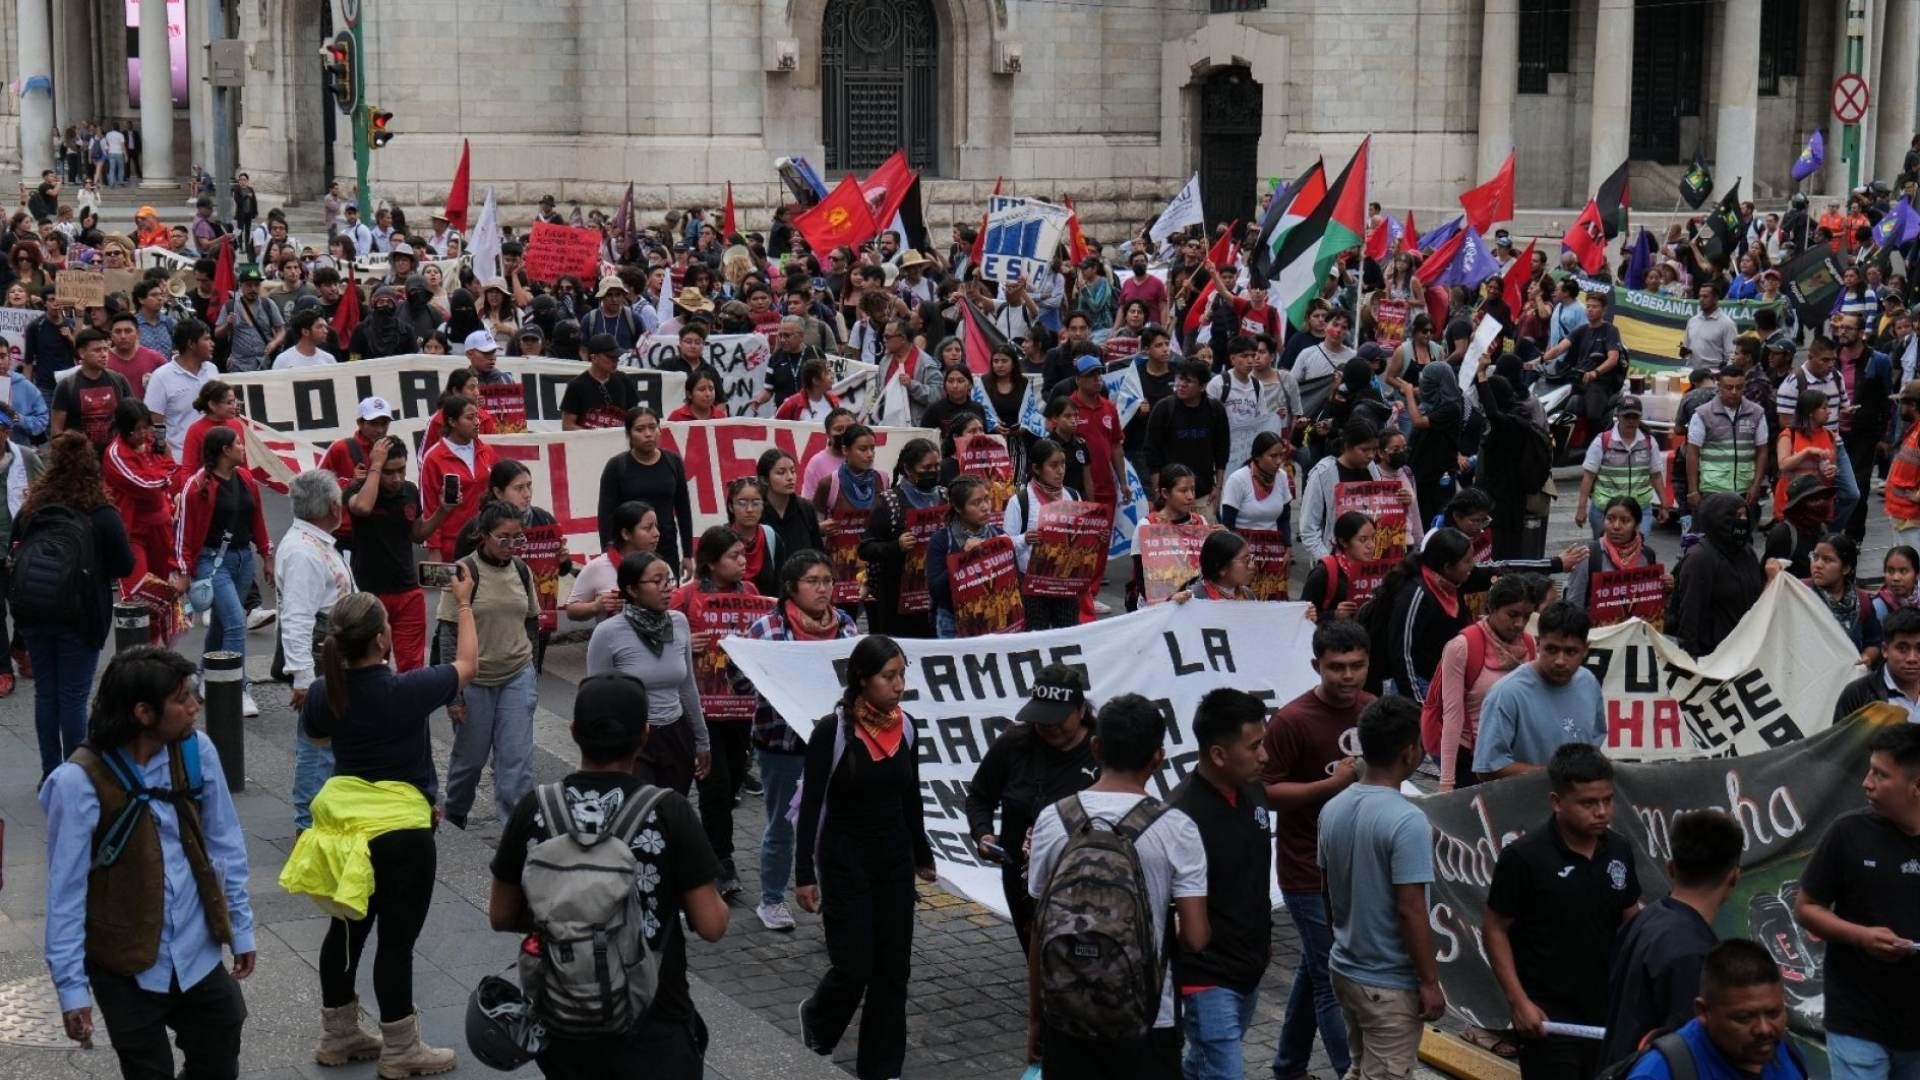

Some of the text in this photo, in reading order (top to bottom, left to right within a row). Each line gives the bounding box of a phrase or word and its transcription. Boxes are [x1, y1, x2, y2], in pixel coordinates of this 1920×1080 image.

[1625, 290, 1694, 318] SOBERANÍA
[721, 612, 740, 623] DE
[1164, 628, 1237, 677] LA
